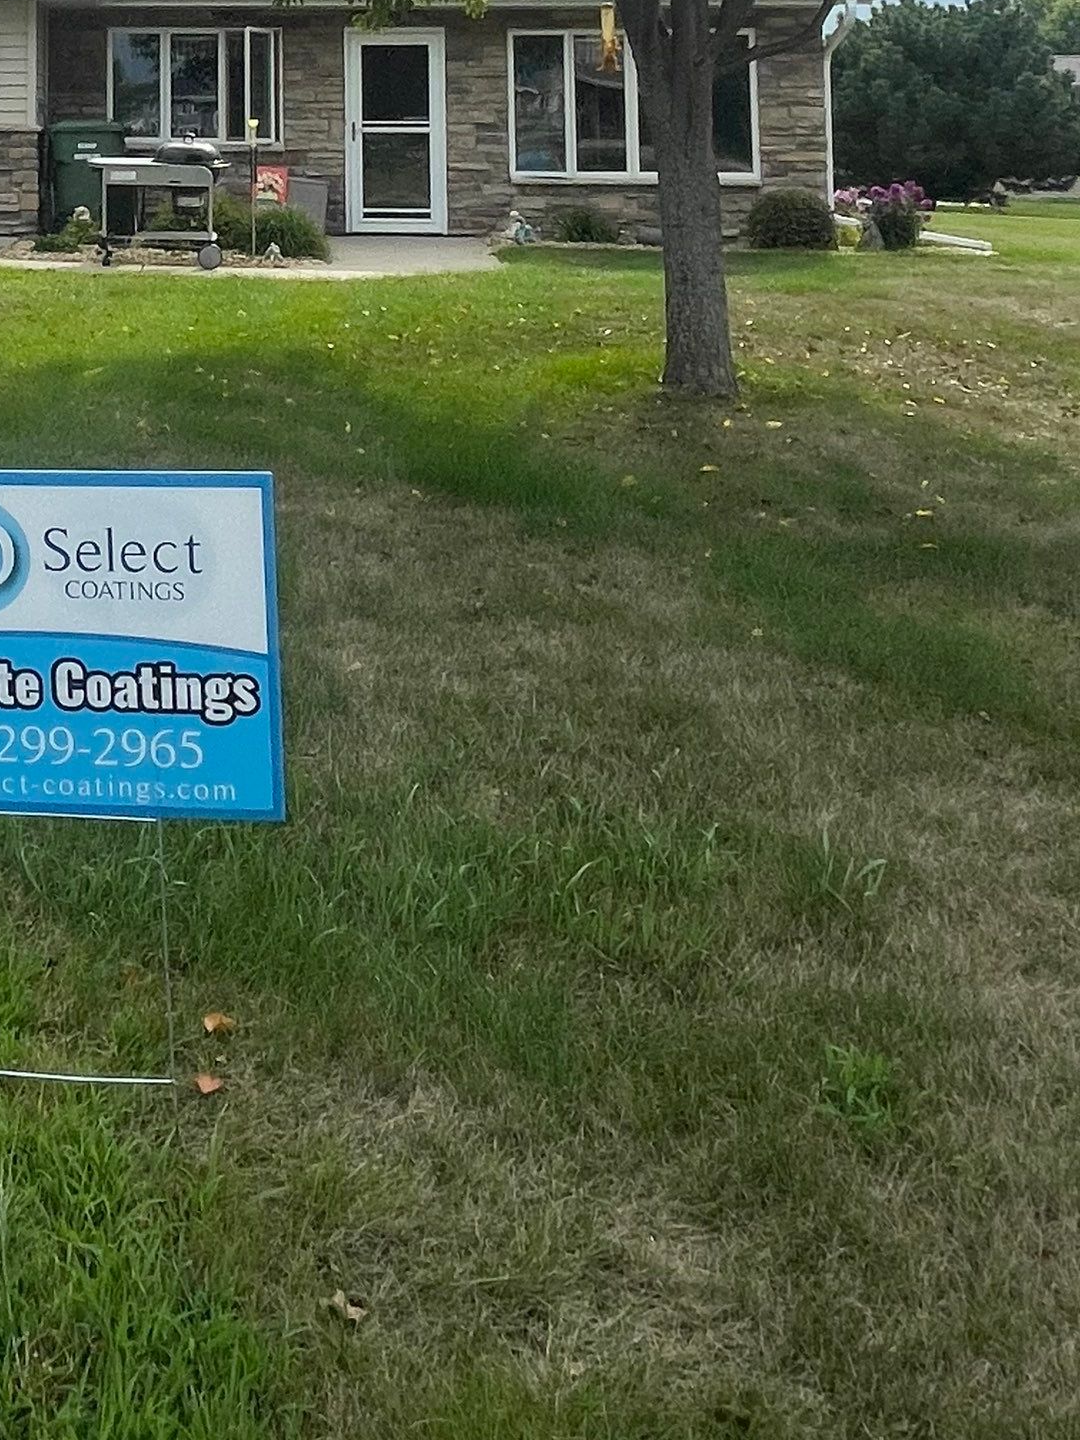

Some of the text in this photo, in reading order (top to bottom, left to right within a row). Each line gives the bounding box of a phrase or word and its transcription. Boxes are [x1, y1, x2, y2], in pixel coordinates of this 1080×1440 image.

[43, 527, 203, 574] Select
[65, 580, 185, 602] COATINGS
[51, 656, 261, 726] Coatings
